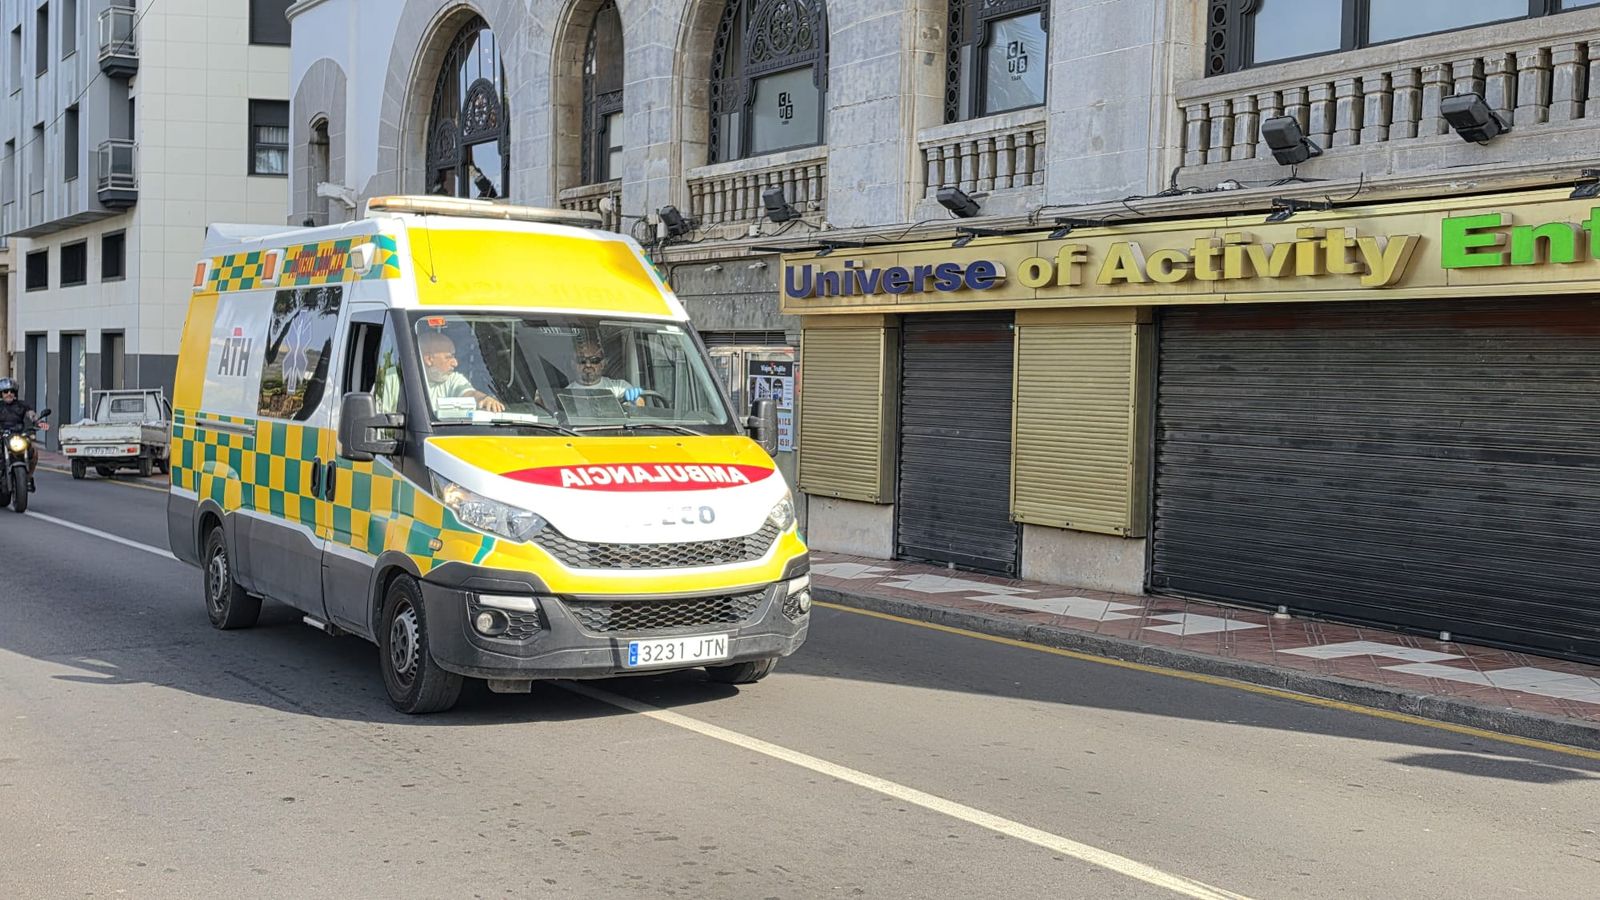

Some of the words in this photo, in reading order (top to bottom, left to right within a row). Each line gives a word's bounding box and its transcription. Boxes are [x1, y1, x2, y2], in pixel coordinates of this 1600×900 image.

[785, 260, 1004, 299] Universe
[1017, 244, 1087, 289] of
[1096, 227, 1421, 288] Activity
[218, 337, 253, 377] ATH
[642, 642, 684, 662] 3231
[693, 638, 725, 658] JTN
